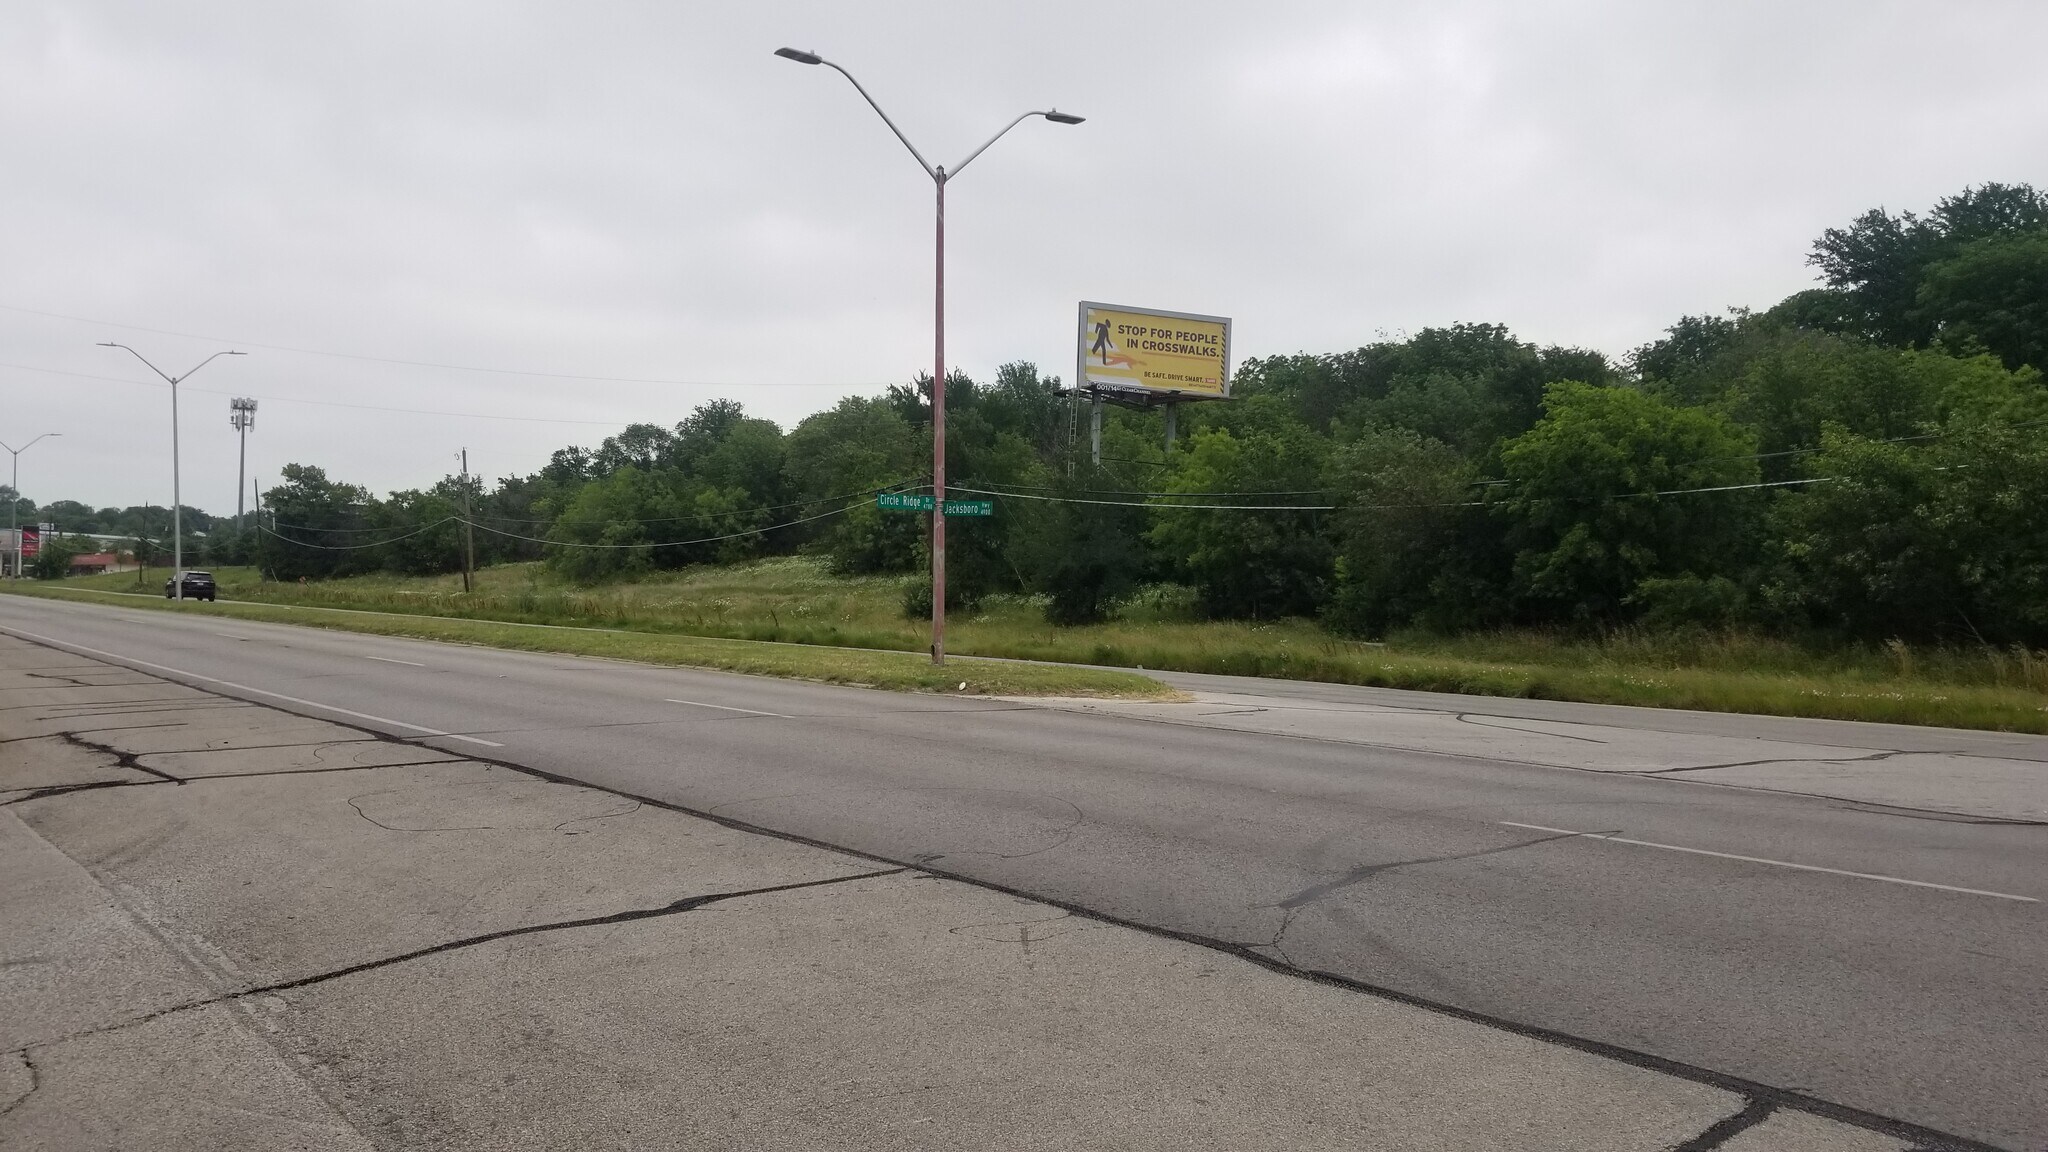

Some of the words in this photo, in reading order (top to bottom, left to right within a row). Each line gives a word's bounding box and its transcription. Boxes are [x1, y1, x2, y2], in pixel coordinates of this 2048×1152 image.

[1118, 325, 1147, 336] STOP
[1150, 328, 1172, 339] FOR
[1176, 331, 1218, 345] PEOPLE
[1127, 338, 1138, 348] IN
[1142, 340, 1220, 357] CROSSWALKS.
[1168, 373, 1183, 381] DRIVE
[1185, 375, 1203, 383] SMART.
[880, 494, 899, 506] Circle
[903, 495, 920, 509] Ridge
[944, 503, 979, 514] Jacksboro
